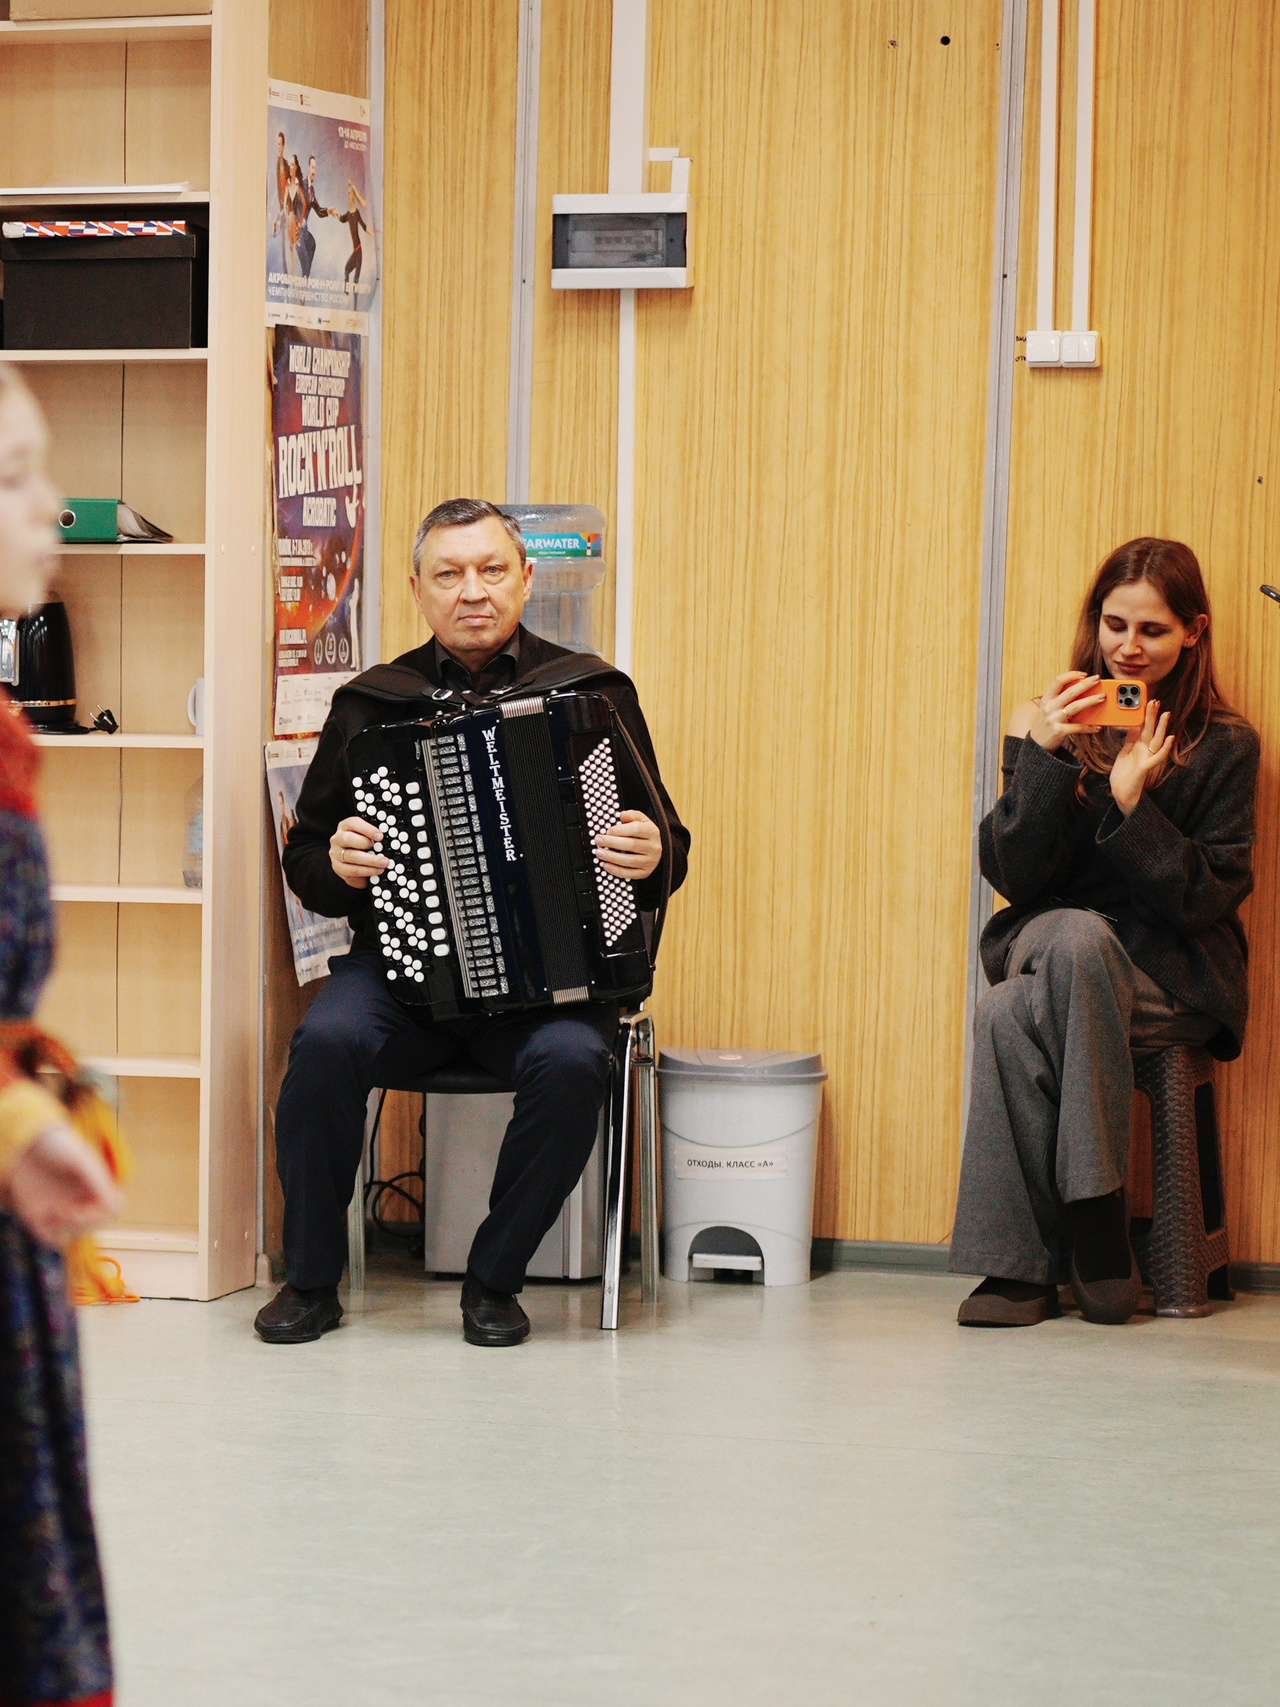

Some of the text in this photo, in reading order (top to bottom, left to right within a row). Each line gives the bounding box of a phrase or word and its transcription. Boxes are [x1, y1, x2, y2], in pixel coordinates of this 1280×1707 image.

[289, 344, 351, 378] WORLD CHAMPIONSHIP
[302, 395, 339, 428] WORLD CUP
[278, 424, 362, 499] ROCK'N'ROLL
[303, 496, 337, 527] ACROBATIC
[481, 725, 517, 862] WELTMEISTER
[686, 1158, 774, 1169] ОТХОДЫ. КЛАСС «А»
